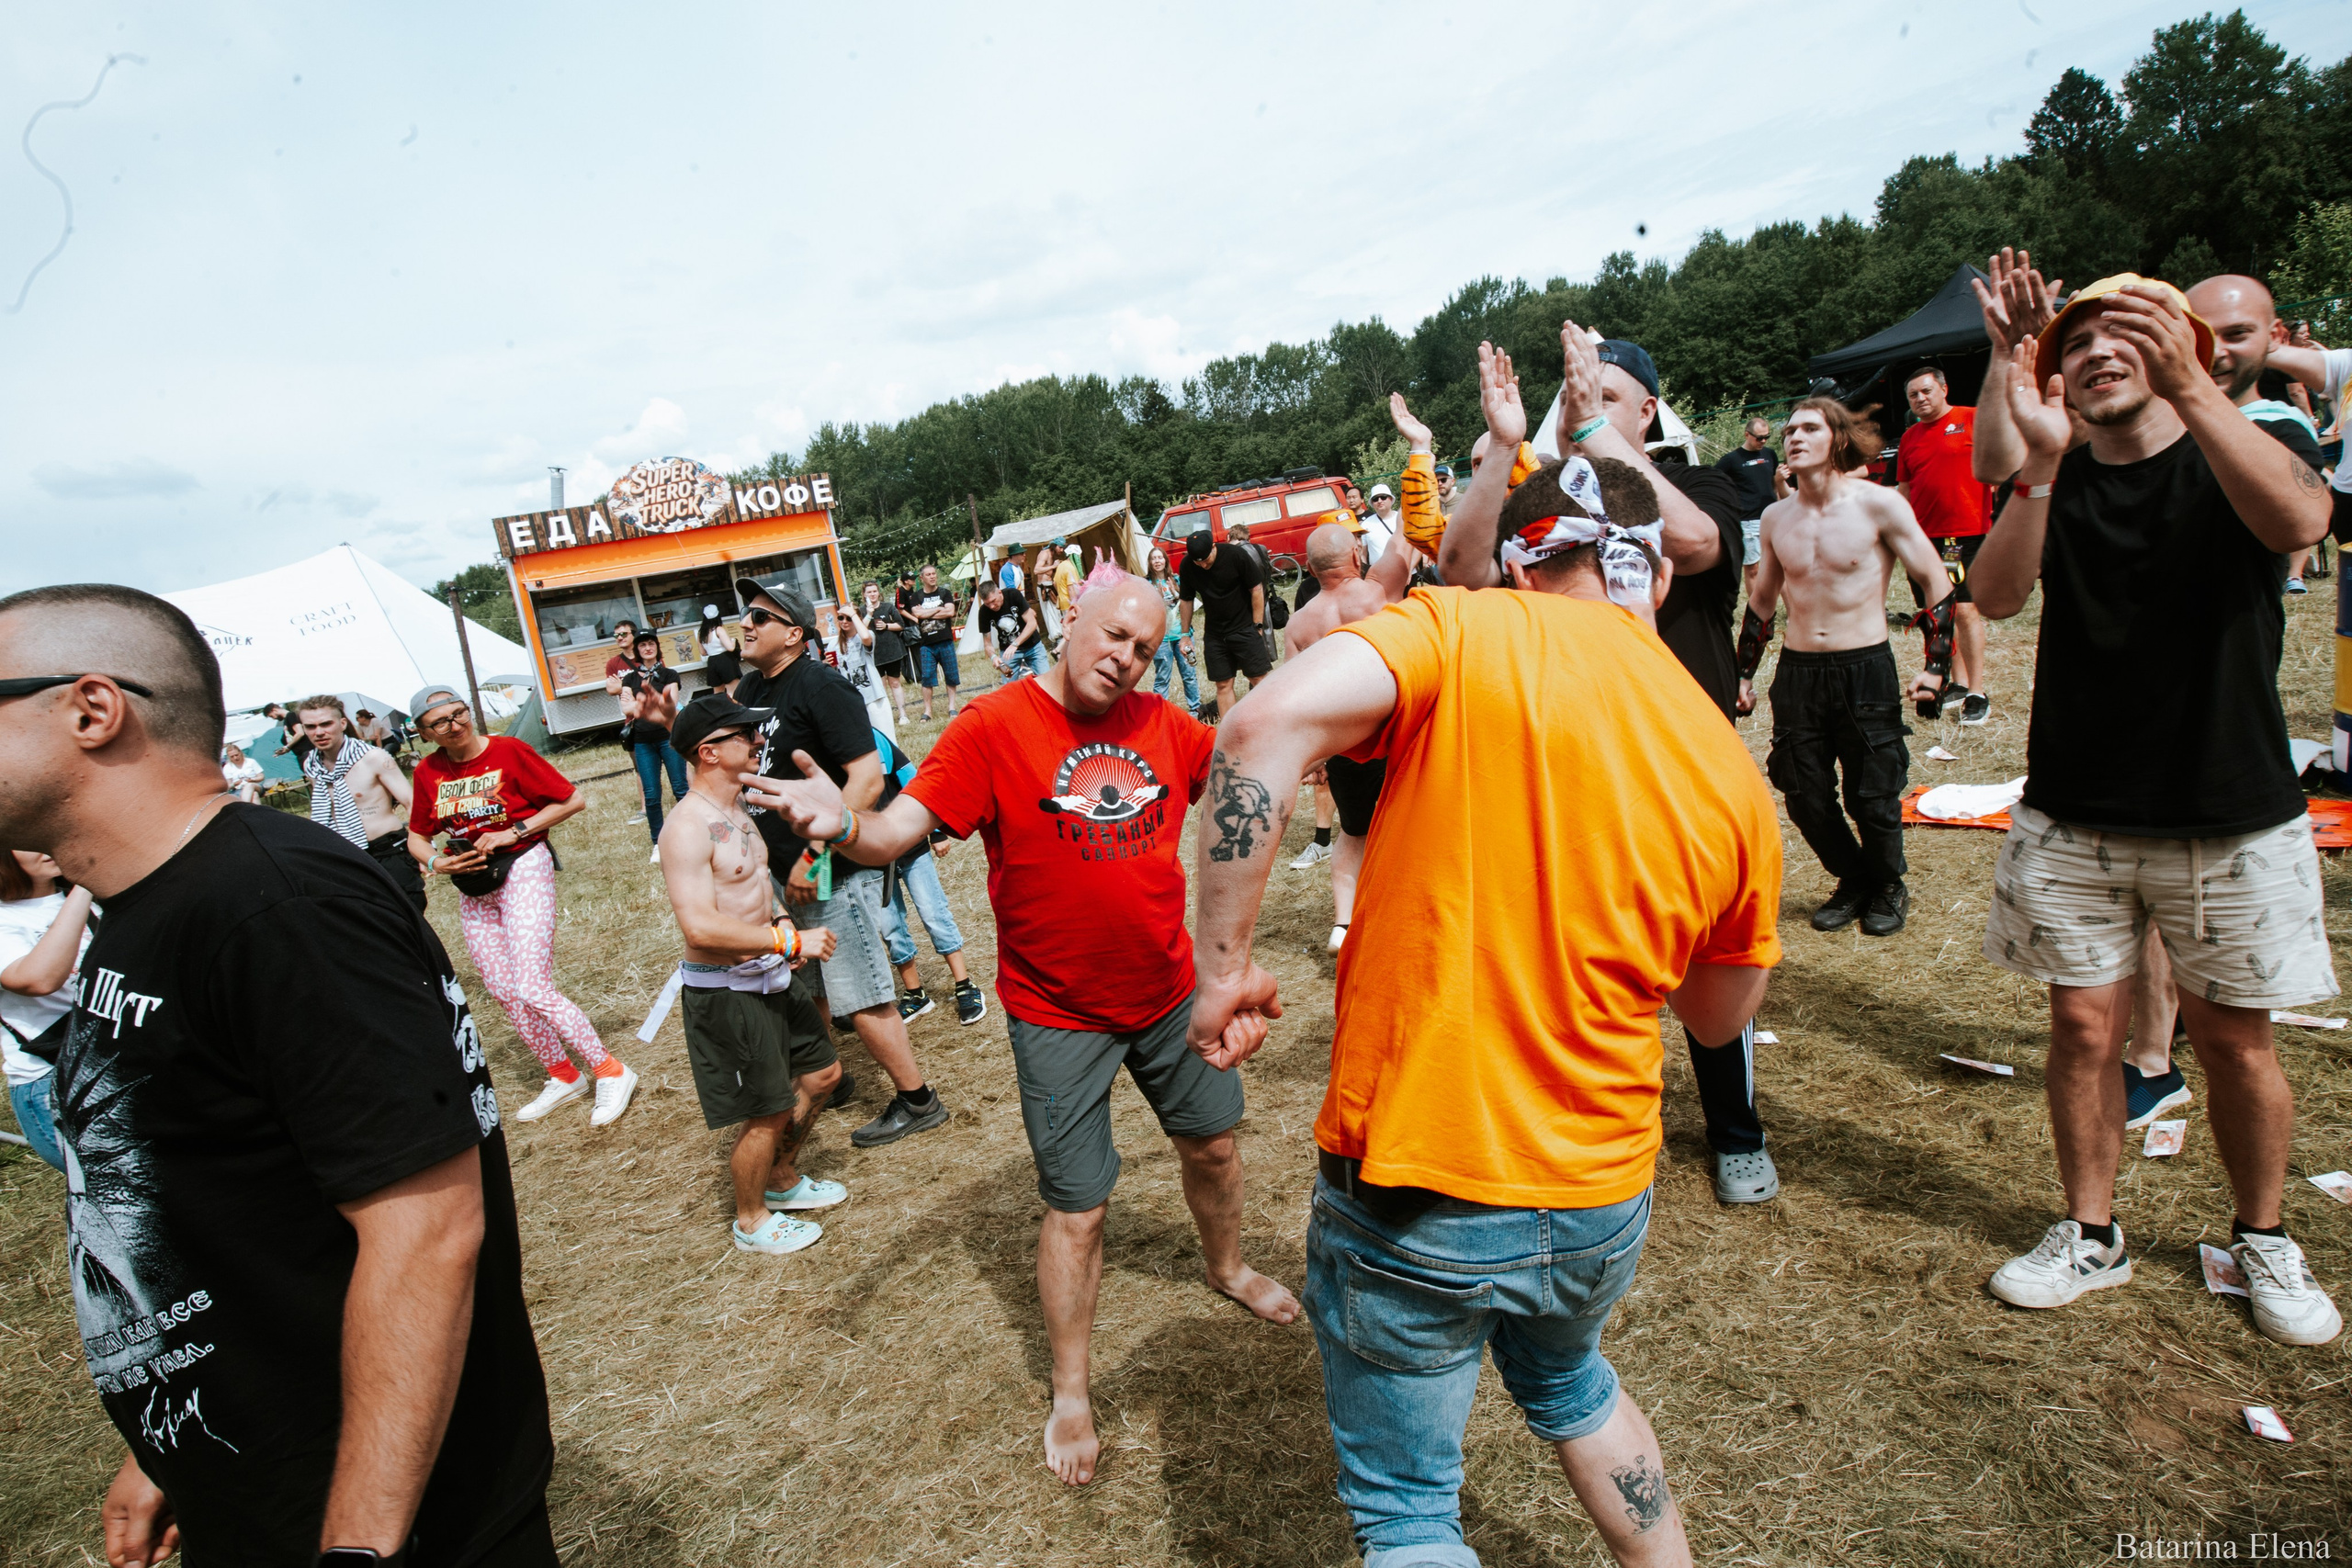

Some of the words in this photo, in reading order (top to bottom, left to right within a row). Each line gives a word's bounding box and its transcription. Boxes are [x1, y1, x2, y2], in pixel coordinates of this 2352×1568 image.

[630, 462, 696, 494] SUPER
[643, 480, 692, 506] HERO
[735, 479, 834, 514] КОФЕ
[639, 494, 703, 525] TRUCK
[508, 511, 612, 548] ЕДА
[289, 601, 353, 626] CRAFT
[300, 615, 356, 637] FOOD
[1118, 748, 1153, 777] КУРС
[440, 780, 466, 799] СВОЙ
[1057, 802, 1165, 845] ГРЁБАНЫЙ
[1081, 837, 1156, 862] САППОРТ
